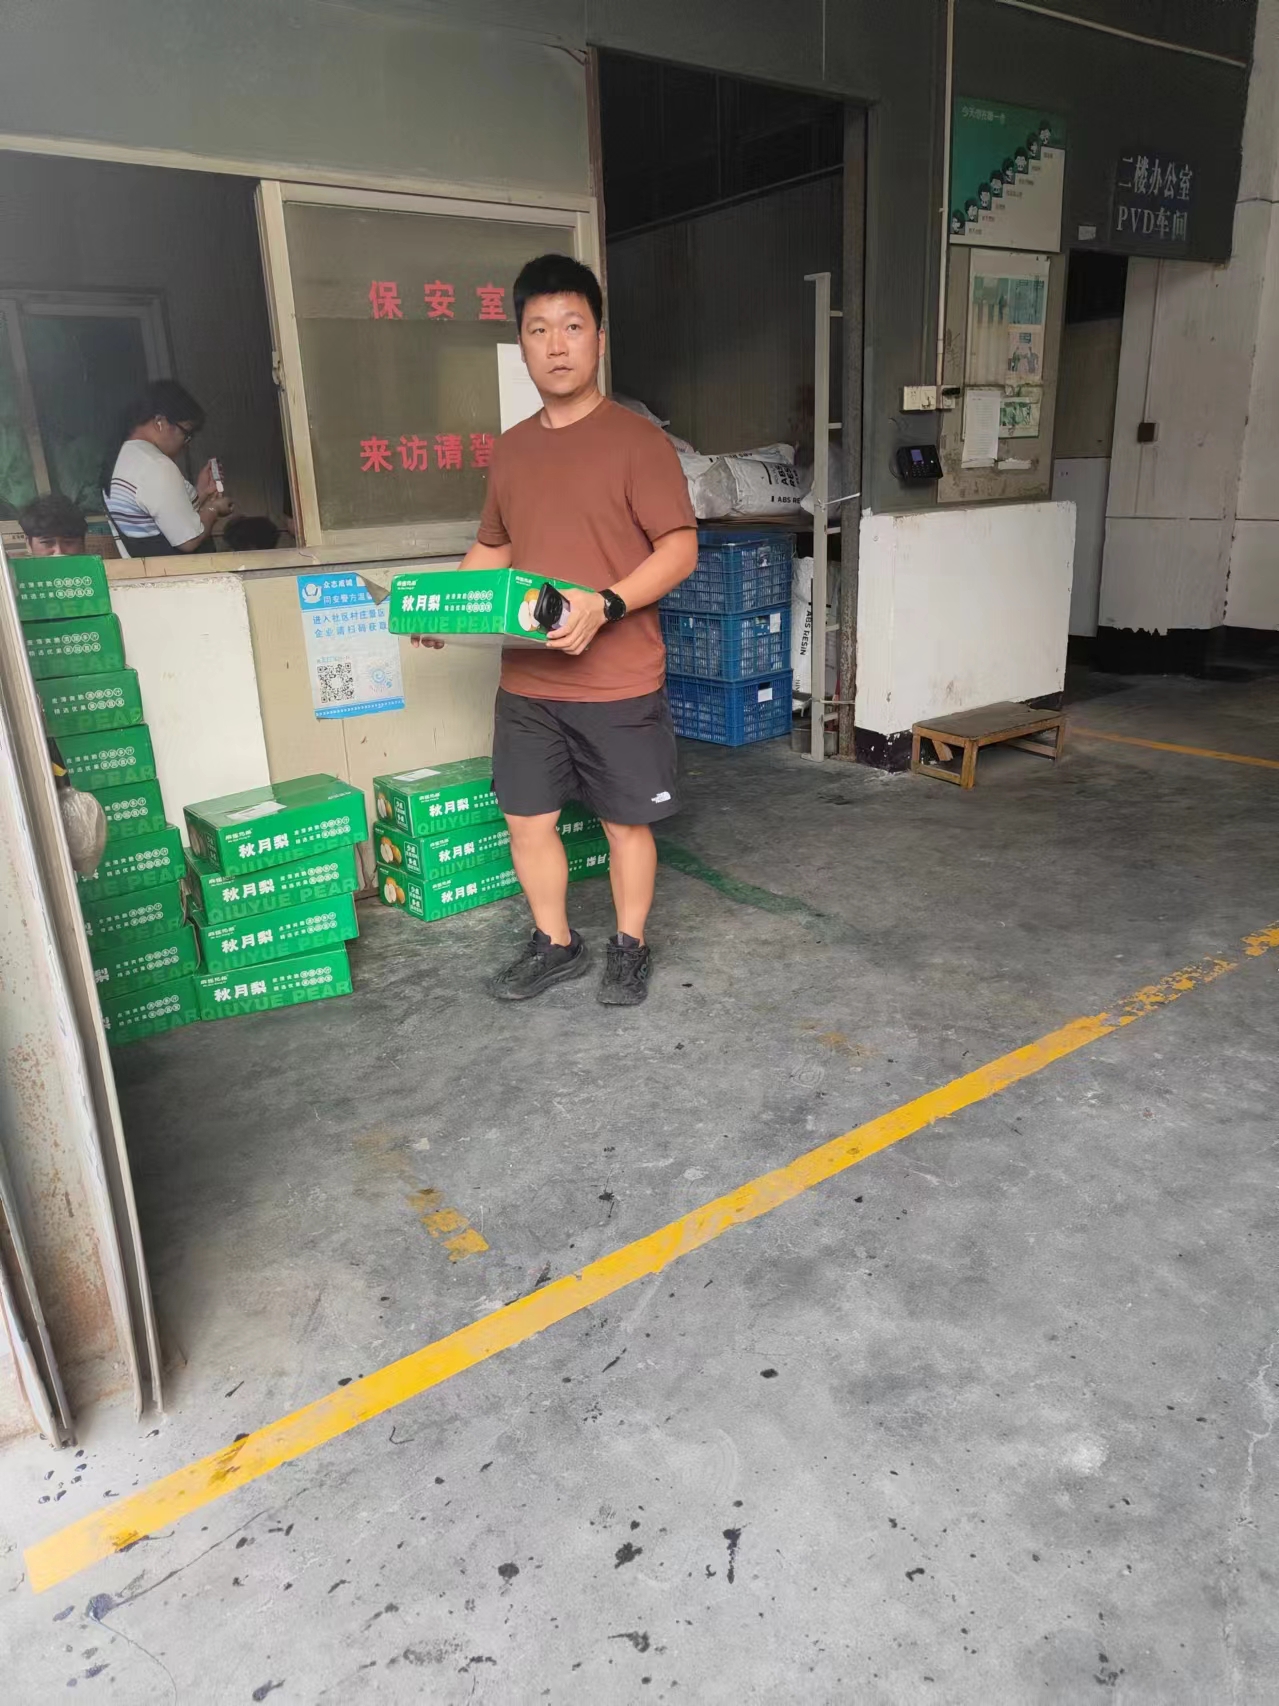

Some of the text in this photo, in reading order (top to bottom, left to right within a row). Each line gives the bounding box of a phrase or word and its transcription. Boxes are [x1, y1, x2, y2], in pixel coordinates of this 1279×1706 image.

[1118, 155, 1192, 200] 二楼办公室
[1116, 205, 1188, 241] PVD车间
[368, 279, 508, 320] 保安室
[777, 496, 791, 504] ABS
[402, 594, 441, 612] 秋月梨
[429, 797, 470, 817] 秋月梨
[418, 810, 482, 835] QIUYUE
[239, 833, 289, 859] 秋月梨
[313, 831, 368, 855] PEAR
[439, 842, 475, 863] 秋月梨
[207, 878, 357, 924] QIUYUE PEAR
[221, 878, 276, 903] 秋月梨
[441, 882, 478, 904] 秋月梨
[208, 943, 290, 973] QIUYUE
[297, 927, 355, 952] PEAR
[221, 928, 274, 954] 秋月梨
[201, 994, 284, 1021] QIUYUE
[292, 980, 352, 1005] PEAR
[213, 980, 267, 1003] 秋月梨
